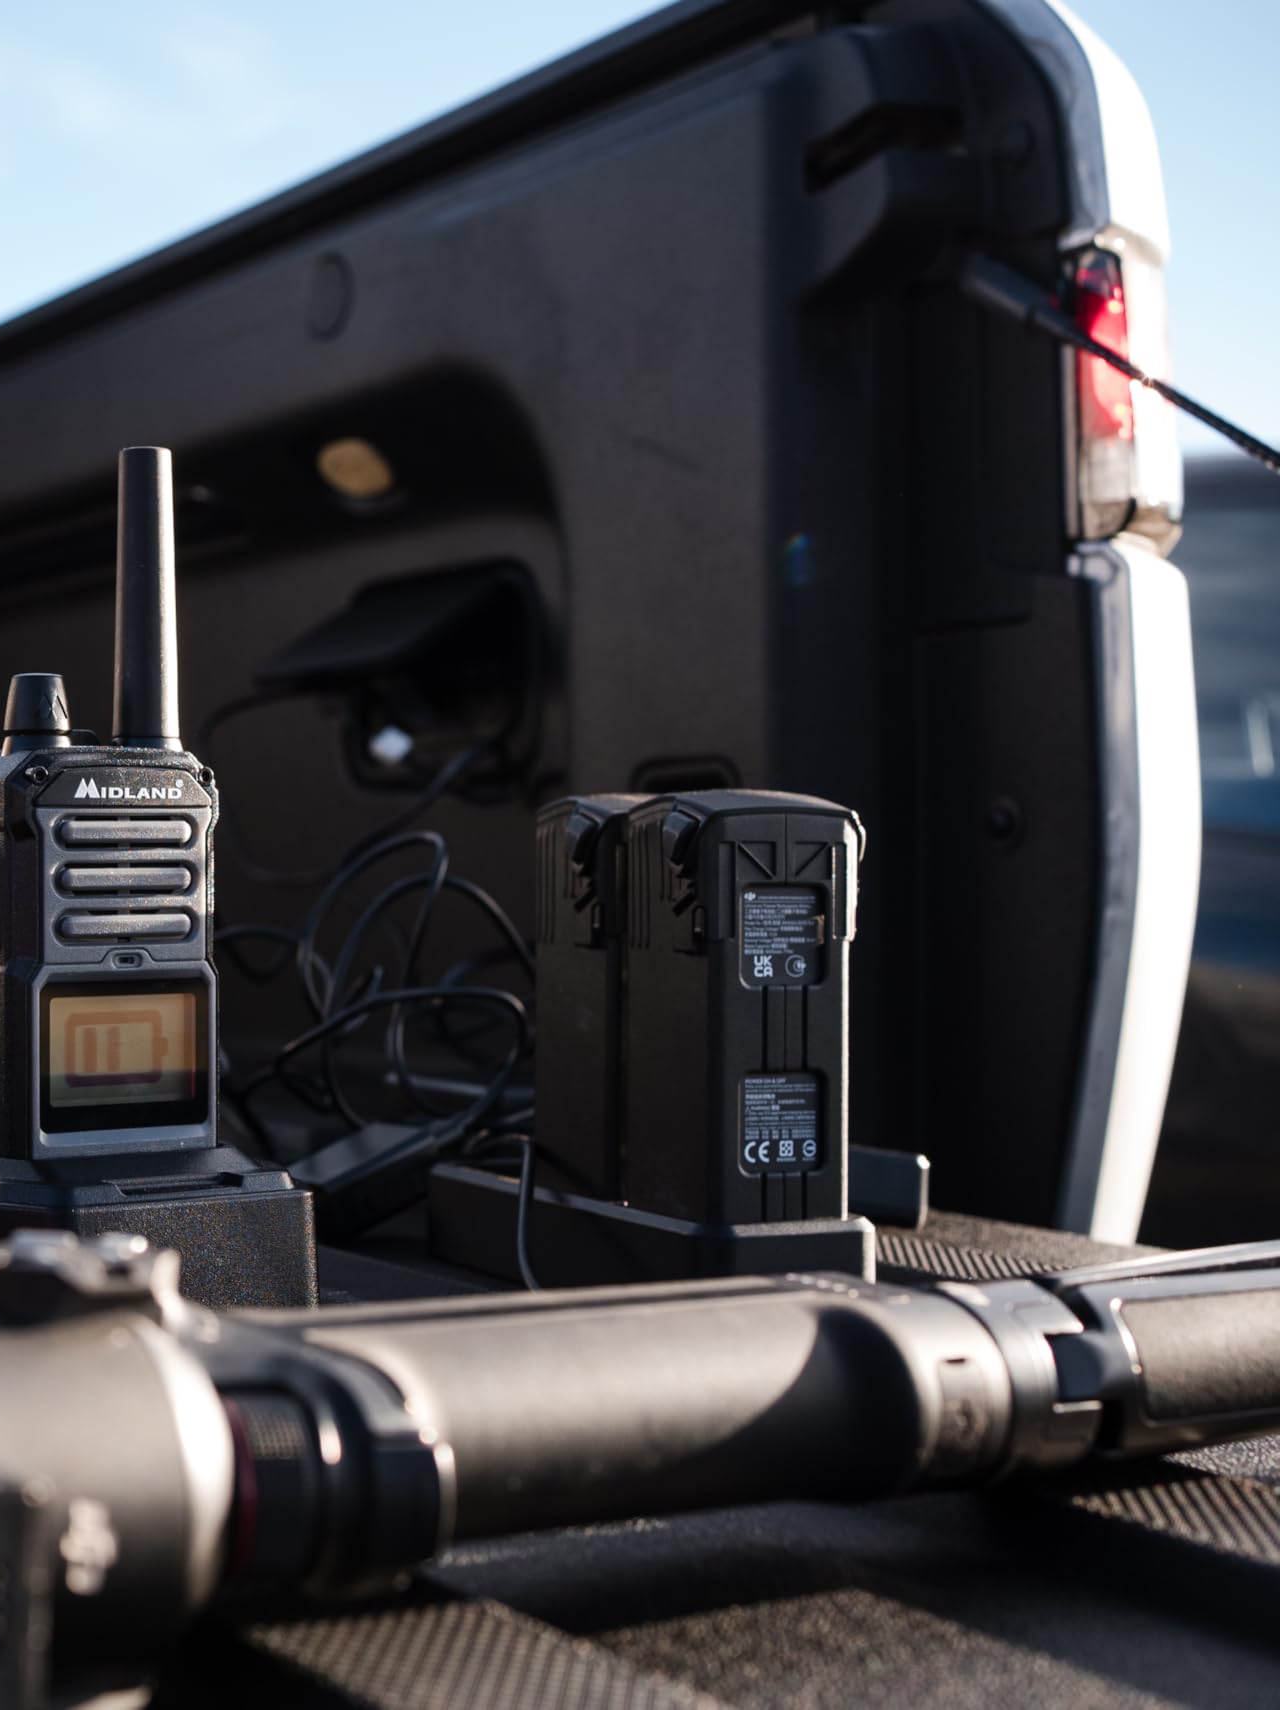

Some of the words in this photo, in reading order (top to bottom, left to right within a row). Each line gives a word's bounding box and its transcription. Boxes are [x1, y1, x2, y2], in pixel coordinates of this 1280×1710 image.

[74, 778, 183, 799] MIDLAND
[754, 955, 772, 966] UK
[754, 967, 773, 977] CA
[744, 1141, 770, 1163] CE
